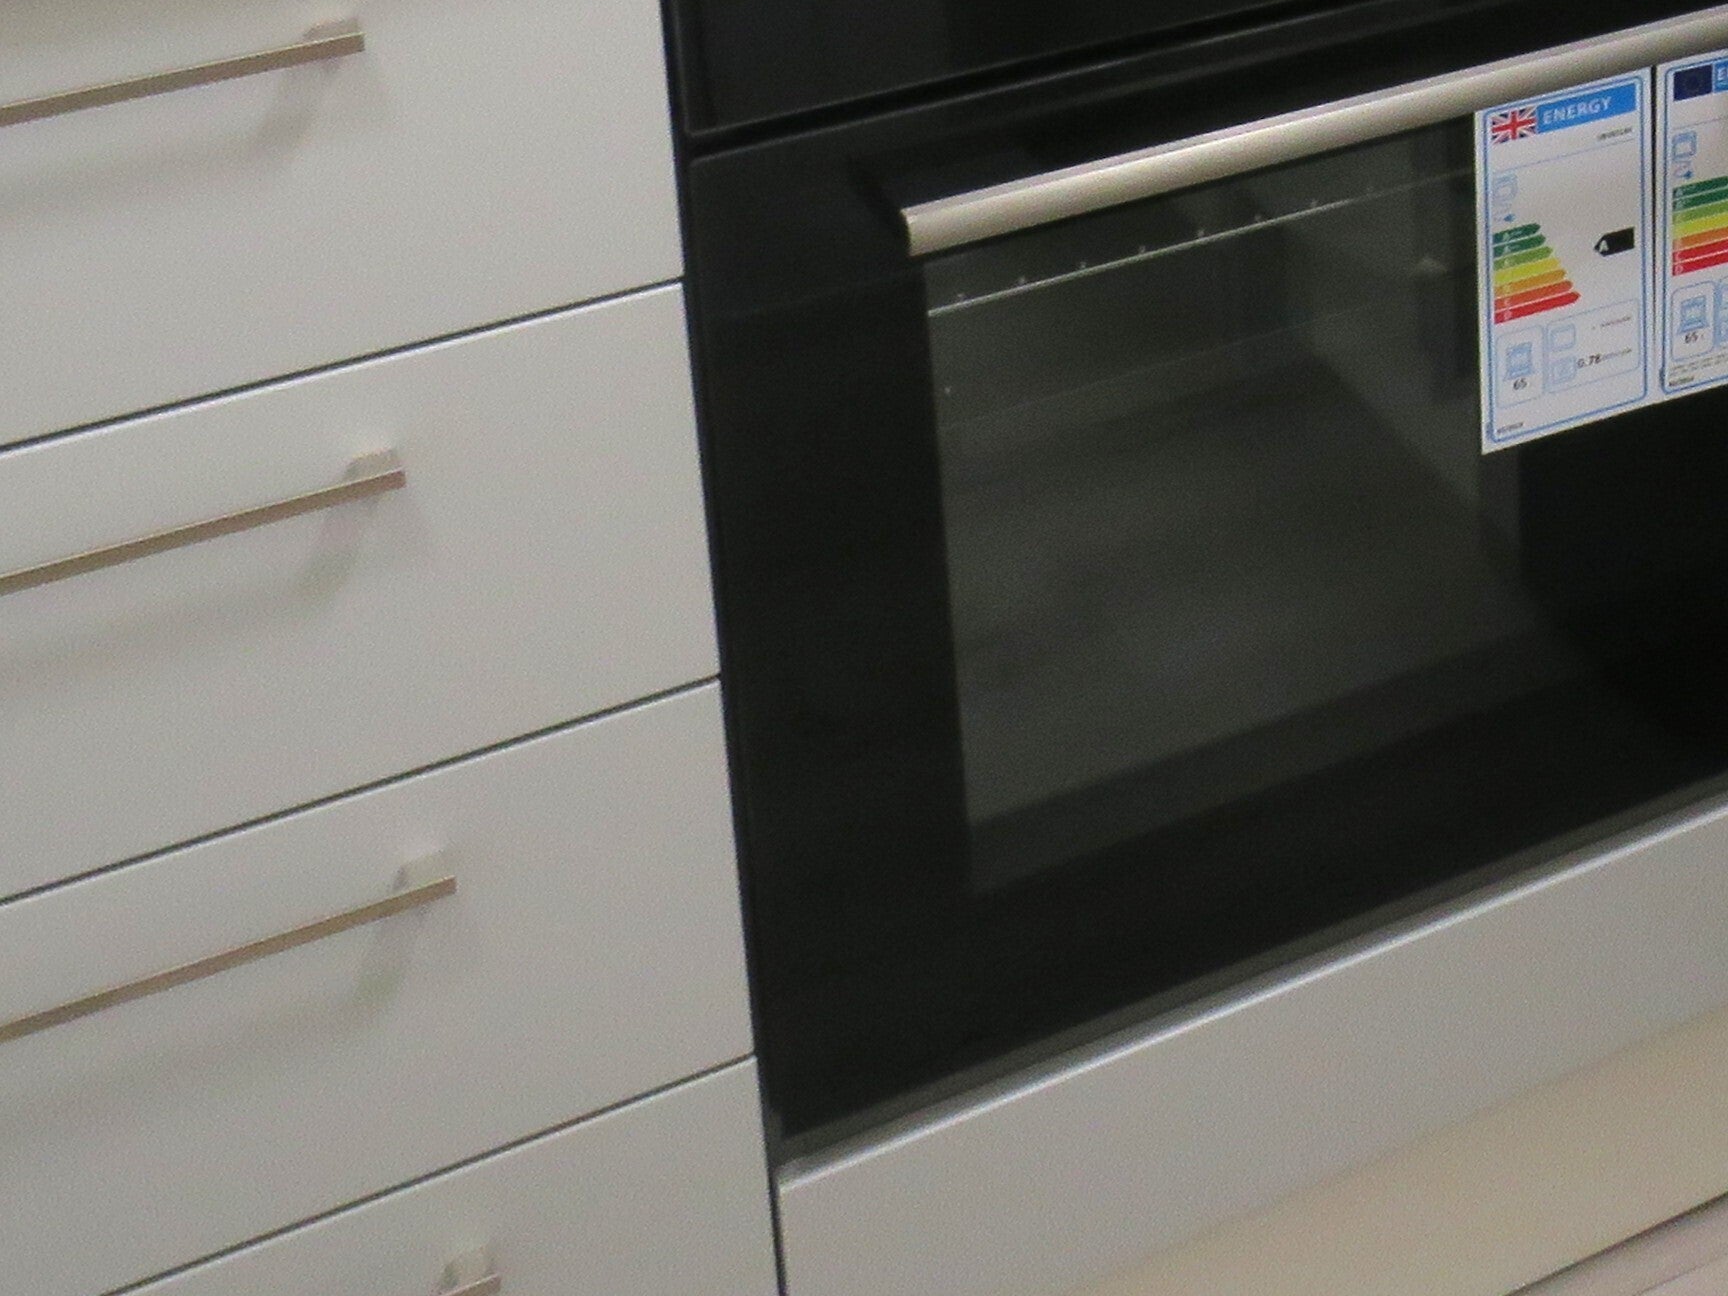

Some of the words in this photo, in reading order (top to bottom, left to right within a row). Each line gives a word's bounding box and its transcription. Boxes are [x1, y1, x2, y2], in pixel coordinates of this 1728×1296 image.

[1543, 95, 1613, 125] ENERGY
[1598, 239, 1609, 252] A
[1684, 331, 1699, 345] 65
[1512, 377, 1528, 391] 65
